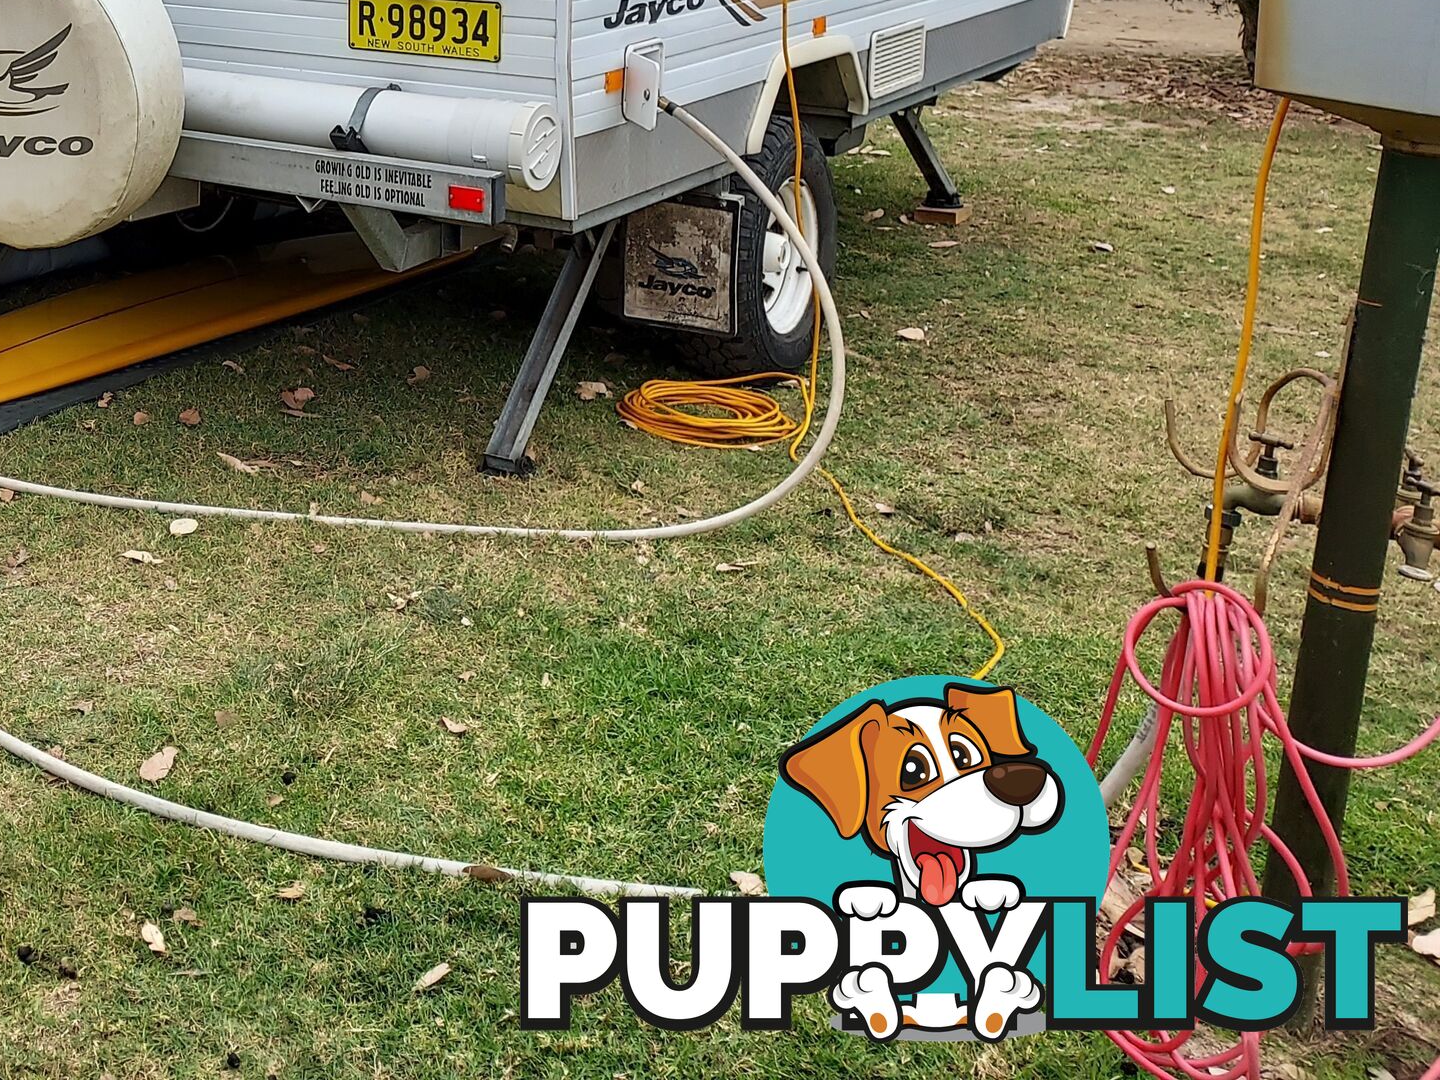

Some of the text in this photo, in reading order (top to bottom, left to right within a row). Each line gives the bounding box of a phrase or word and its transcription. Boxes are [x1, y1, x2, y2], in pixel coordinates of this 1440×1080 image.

[367, 38, 480, 57] NEW SOUTH WALES
[355, 165, 371, 180] OLD
[374, 167, 382, 181] IS
[385, 168, 432, 189] INEVITABLE
[320, 178, 425, 207] FEEING OLD IS OPTIONAL
[638, 274, 713, 299] Jayco
